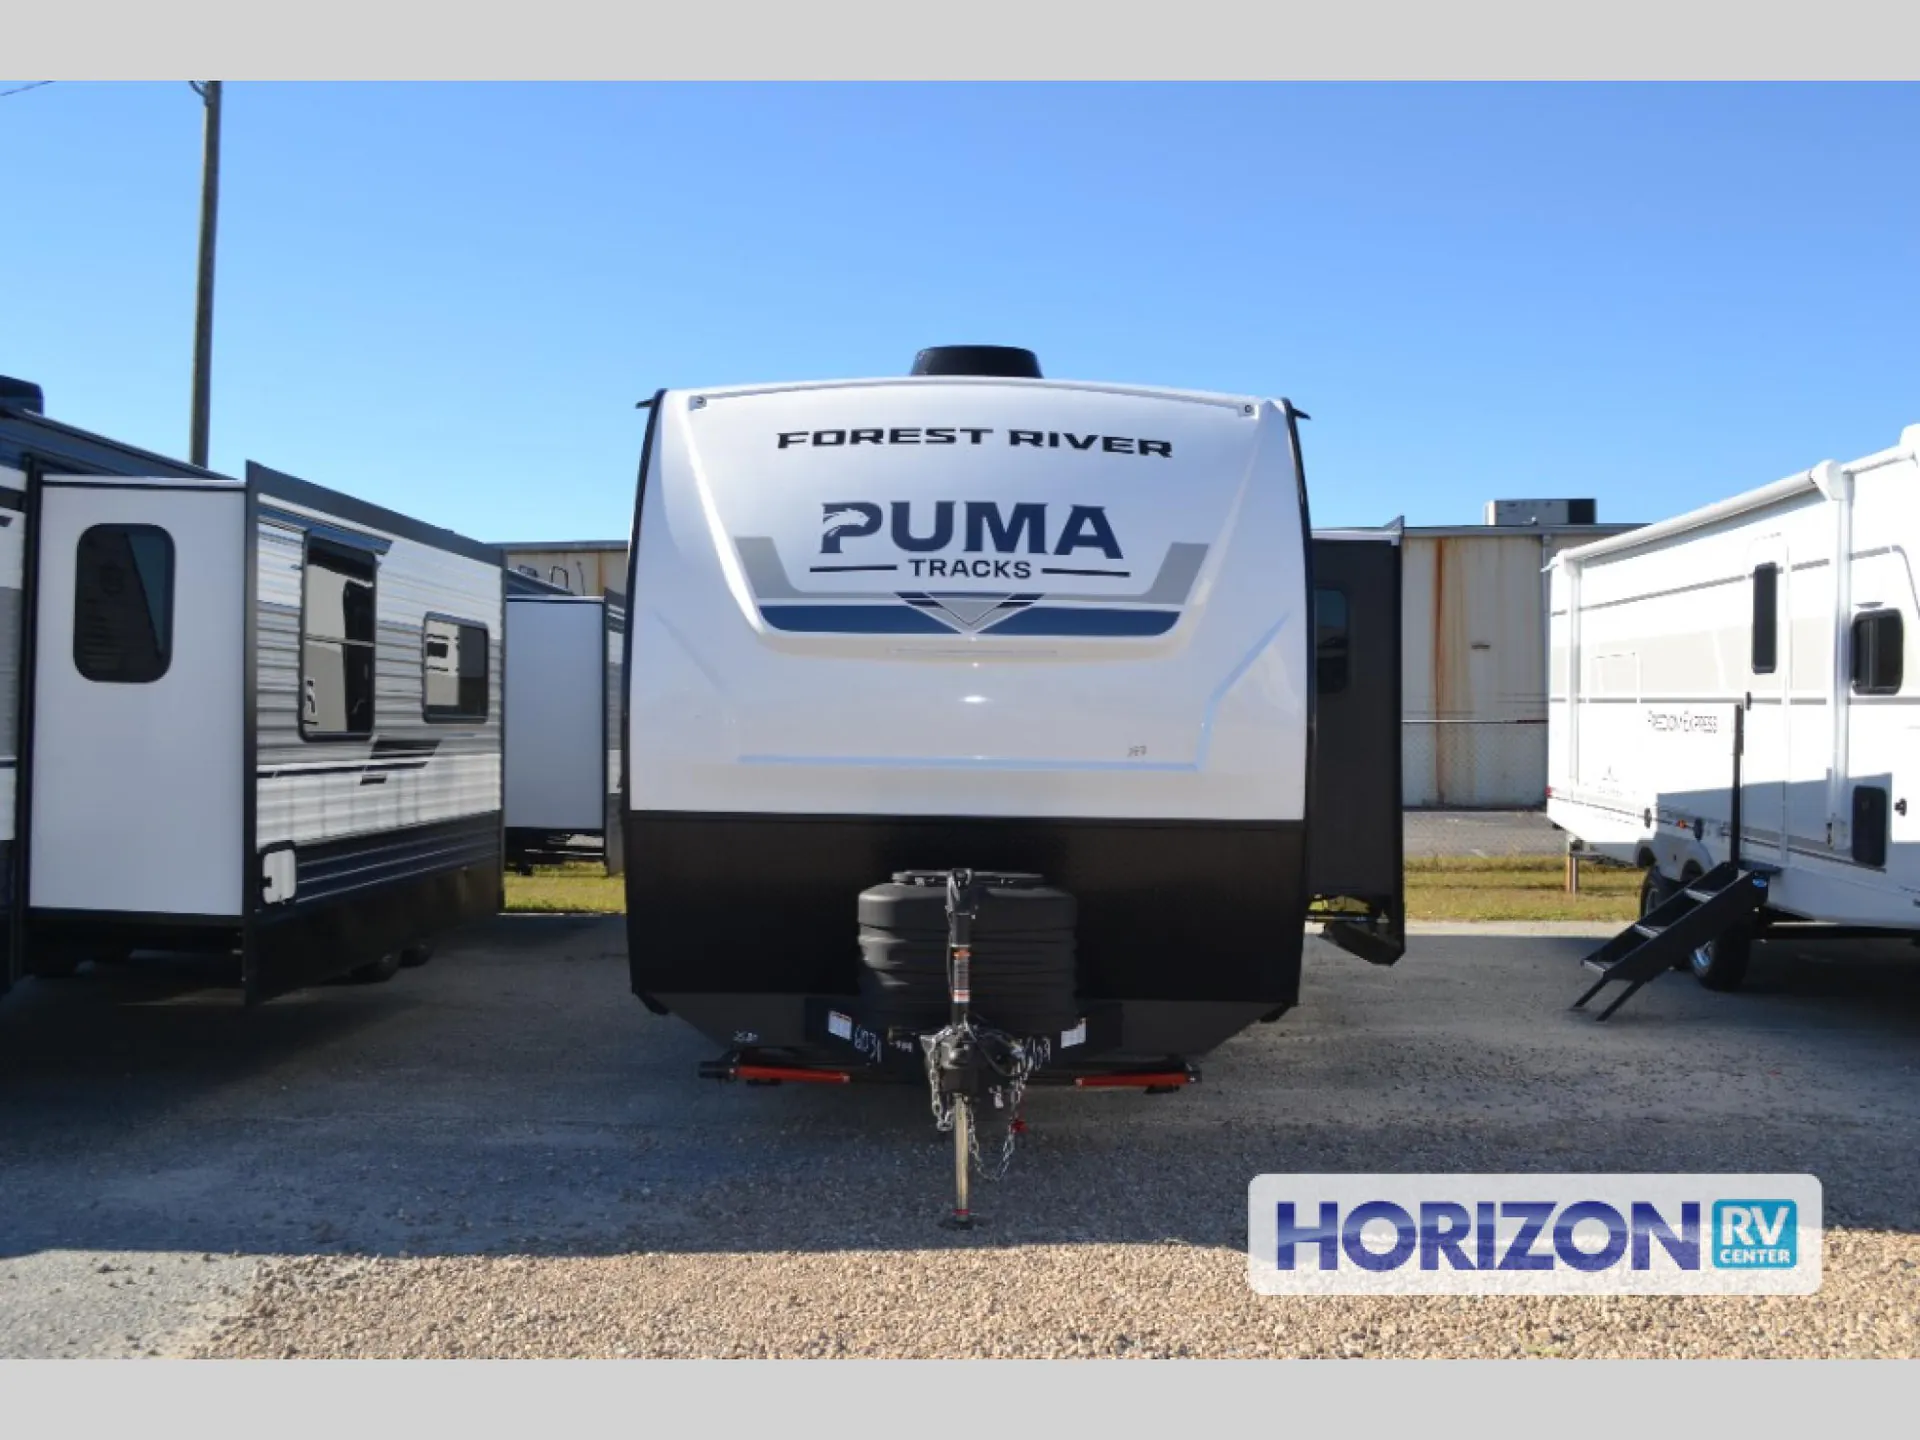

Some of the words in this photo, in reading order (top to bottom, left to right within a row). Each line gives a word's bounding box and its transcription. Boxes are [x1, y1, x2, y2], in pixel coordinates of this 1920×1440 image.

[777, 428, 994, 449] FOREST
[1009, 429, 1172, 458] RIVER
[820, 501, 1124, 560] PUMA
[908, 559, 1032, 579] TRACKS
